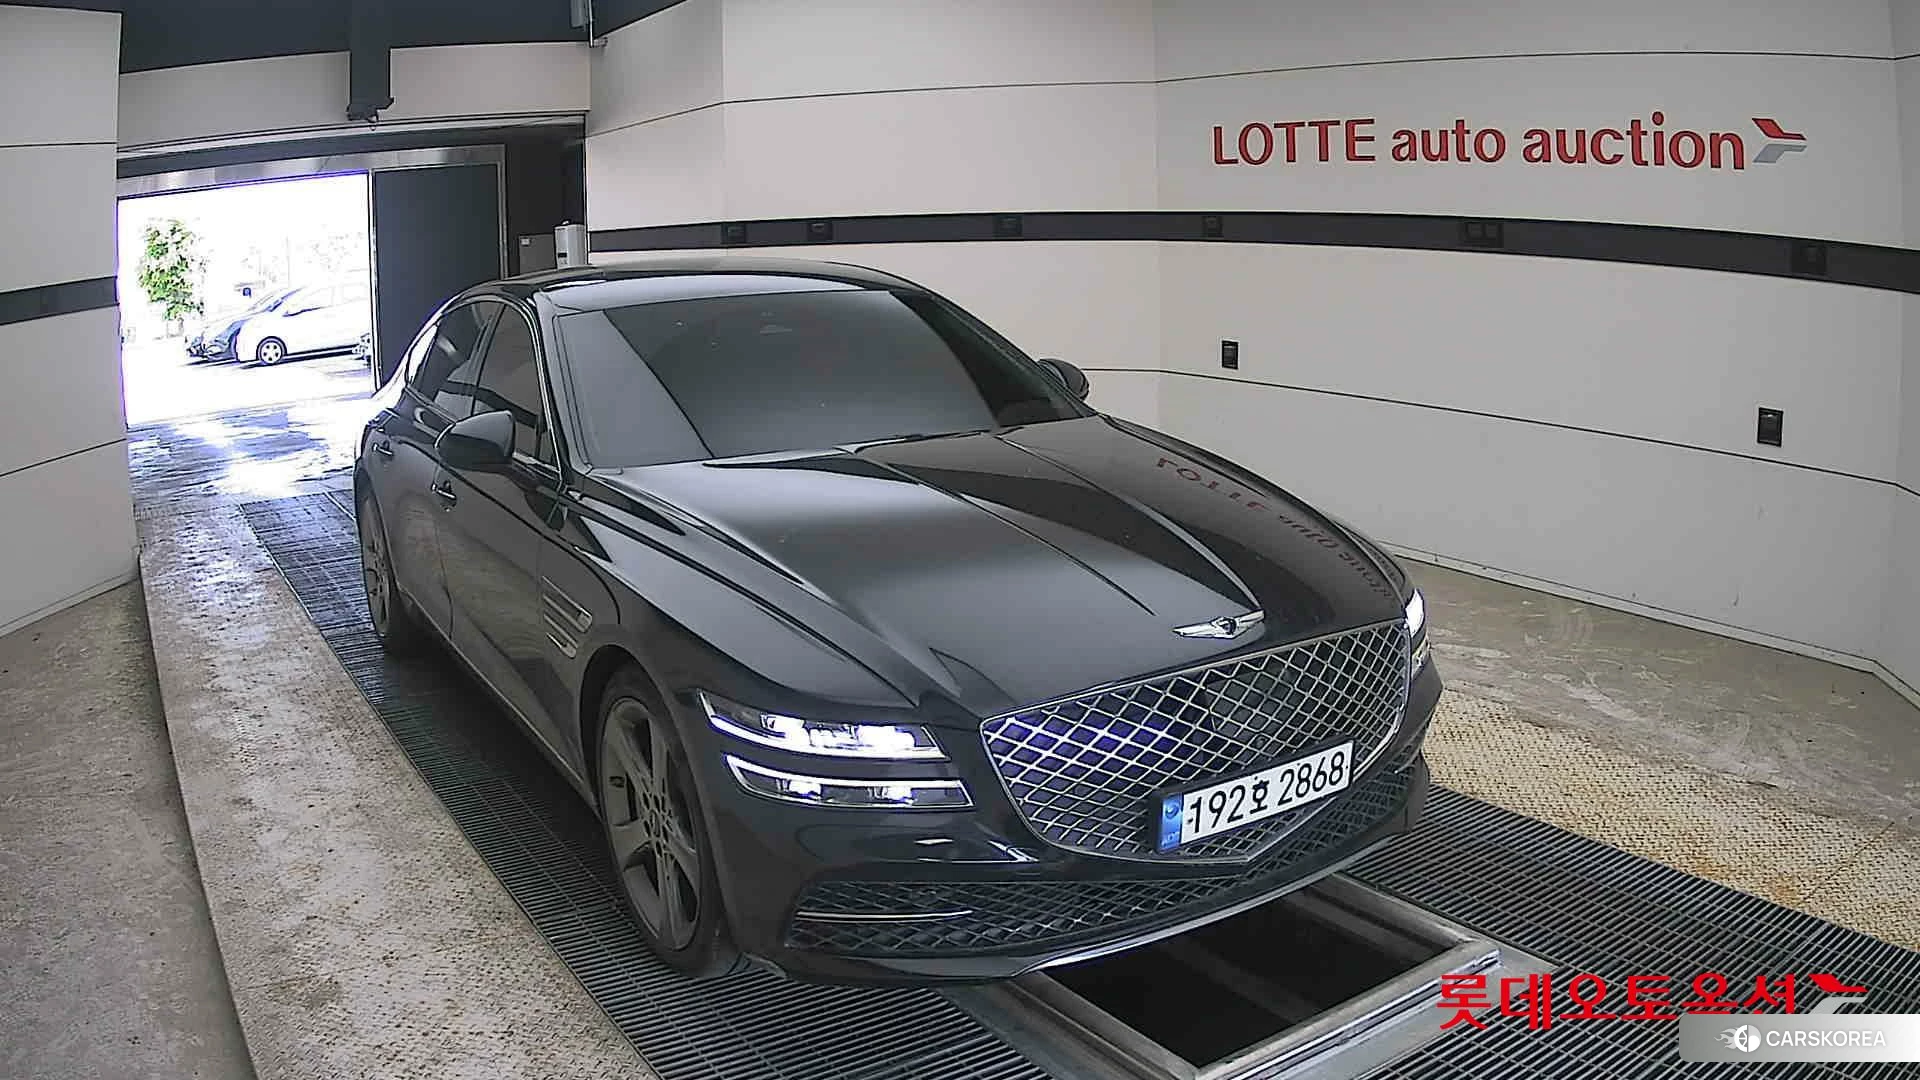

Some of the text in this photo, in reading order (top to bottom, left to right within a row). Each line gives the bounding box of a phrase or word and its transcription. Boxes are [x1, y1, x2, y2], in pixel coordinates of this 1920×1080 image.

[1212, 111, 1746, 171] LOTTE auto auction
[1189, 751, 1345, 834] 192호 2868
